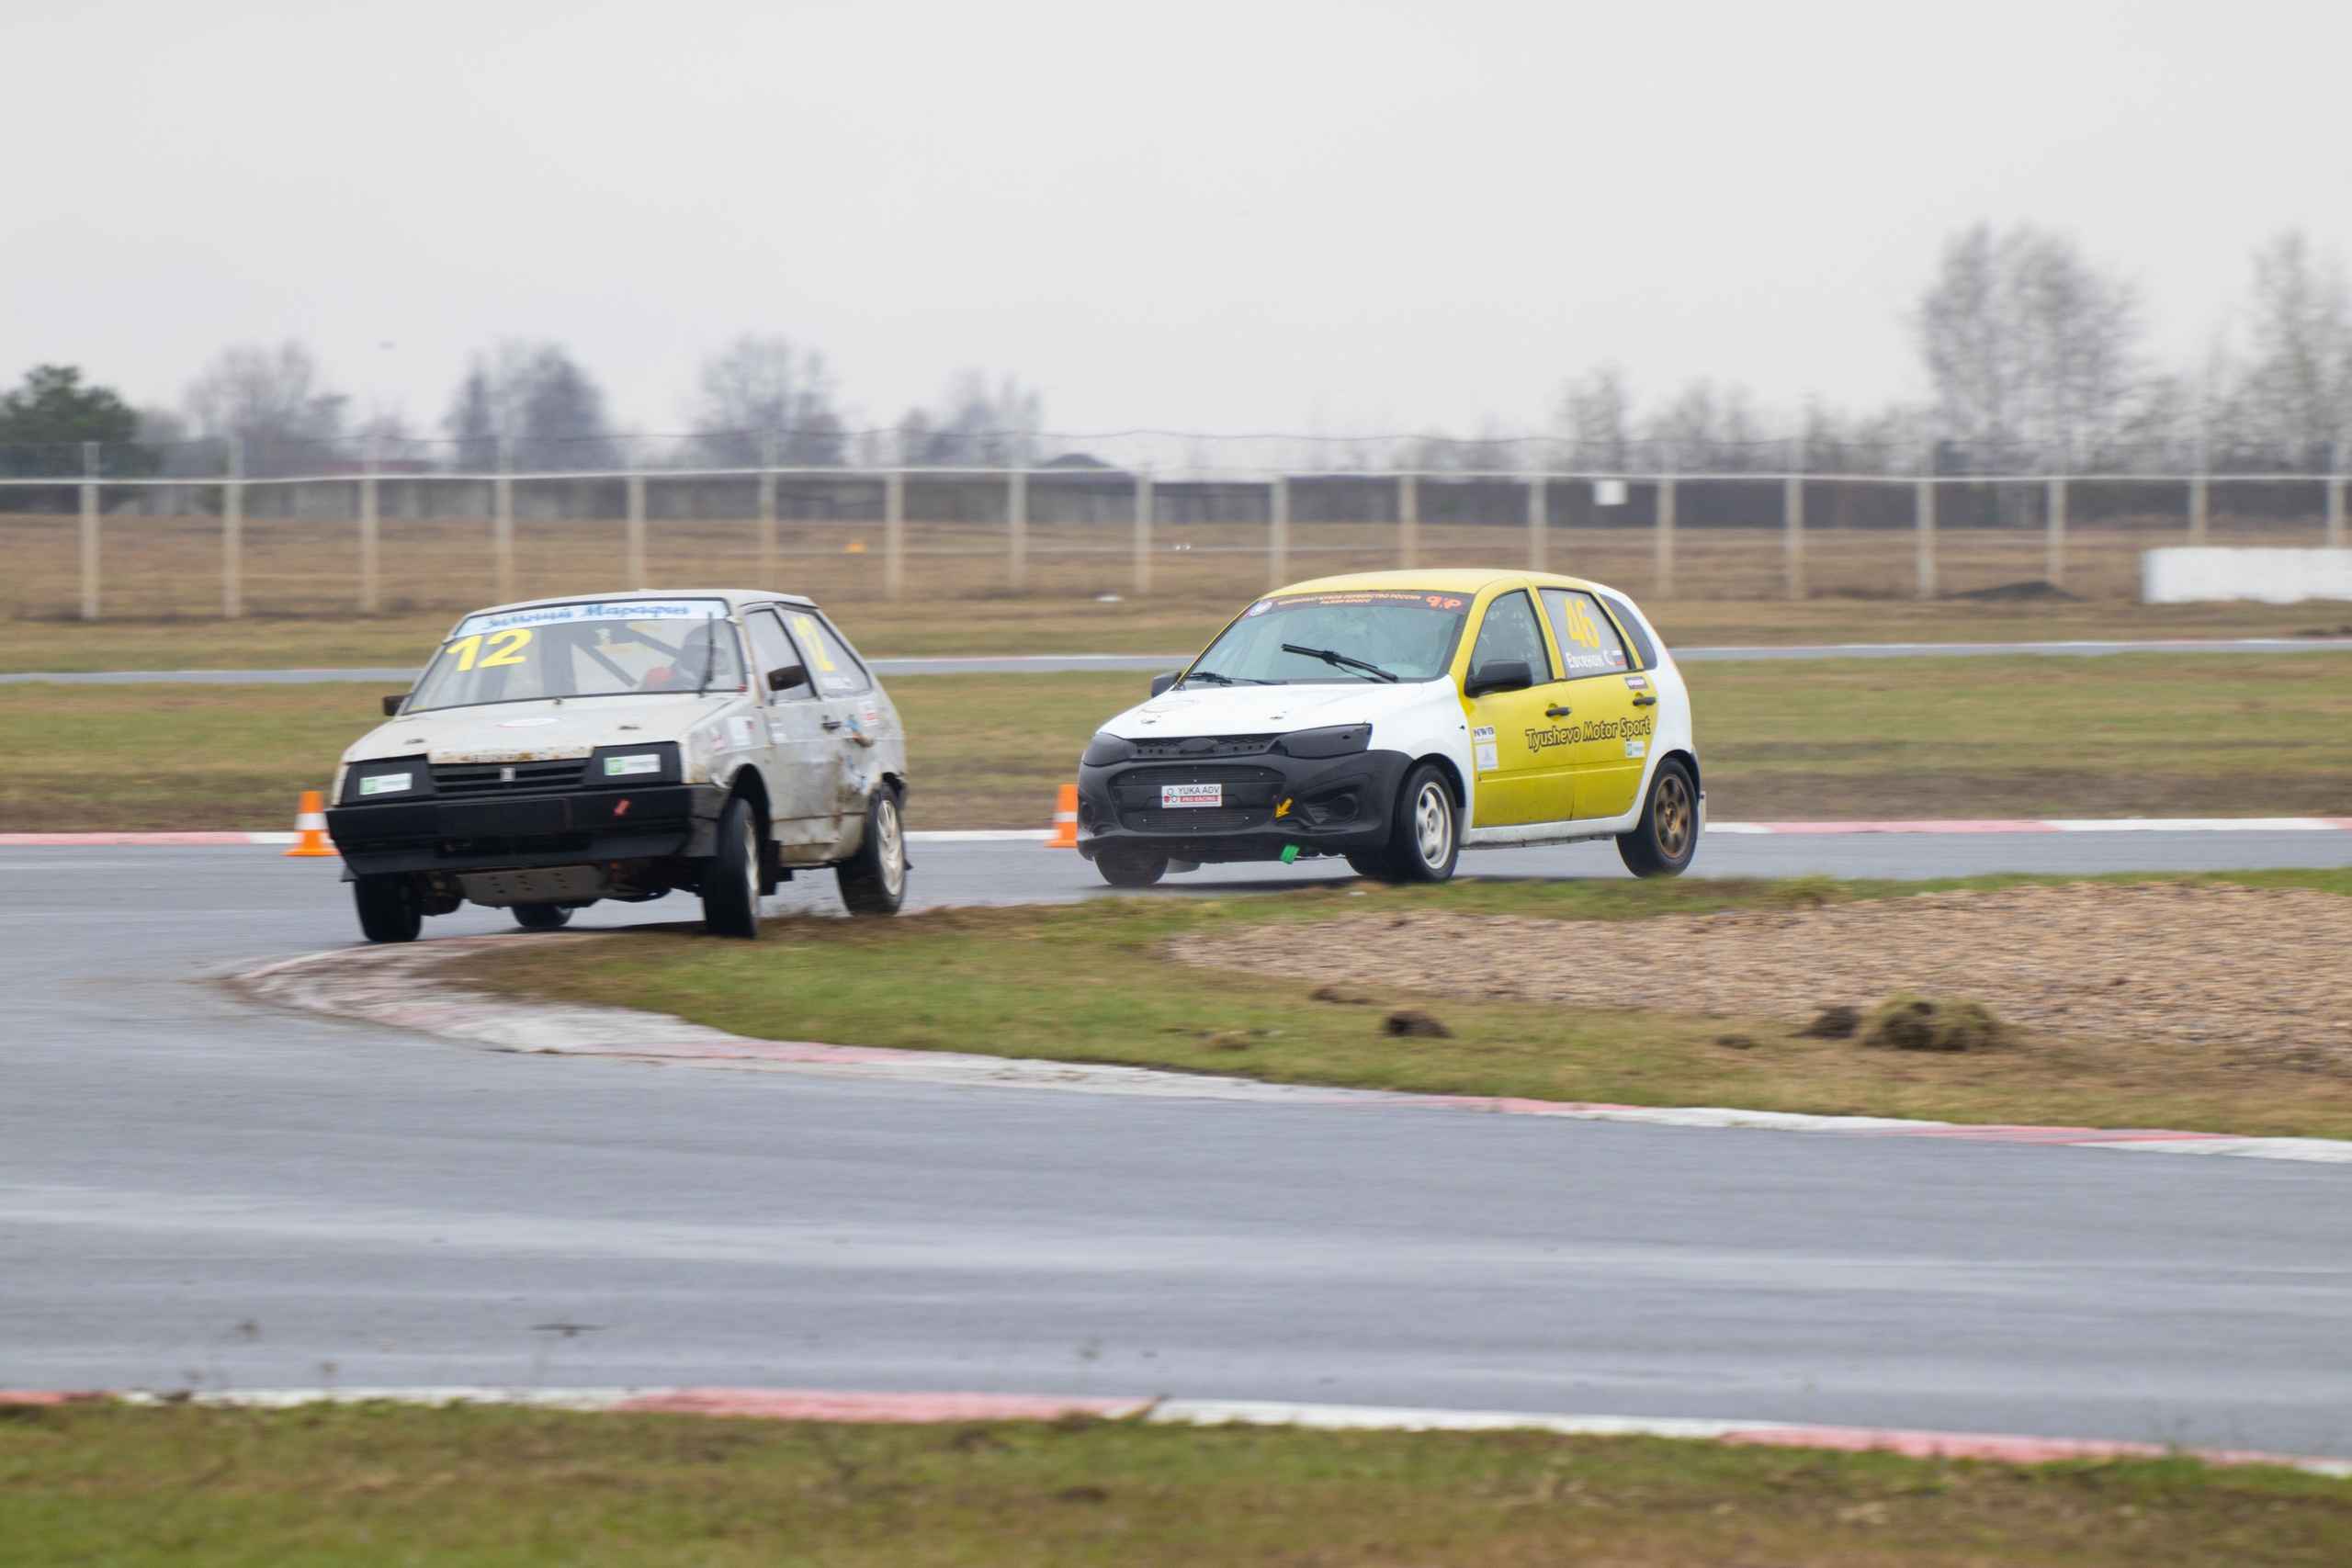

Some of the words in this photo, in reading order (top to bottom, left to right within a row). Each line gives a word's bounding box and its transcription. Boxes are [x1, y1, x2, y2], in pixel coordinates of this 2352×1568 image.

[1277, 596, 1318, 606] ЧЕМПИОНАТ
[1564, 598, 1600, 649] 46
[447, 628, 533, 671] 12
[792, 616, 836, 671] 12
[1473, 727, 1495, 737] NWB
[1525, 726, 1580, 752] Tyushevo
[1583, 719, 1618, 742] Motor
[1620, 716, 1650, 741] Sport
